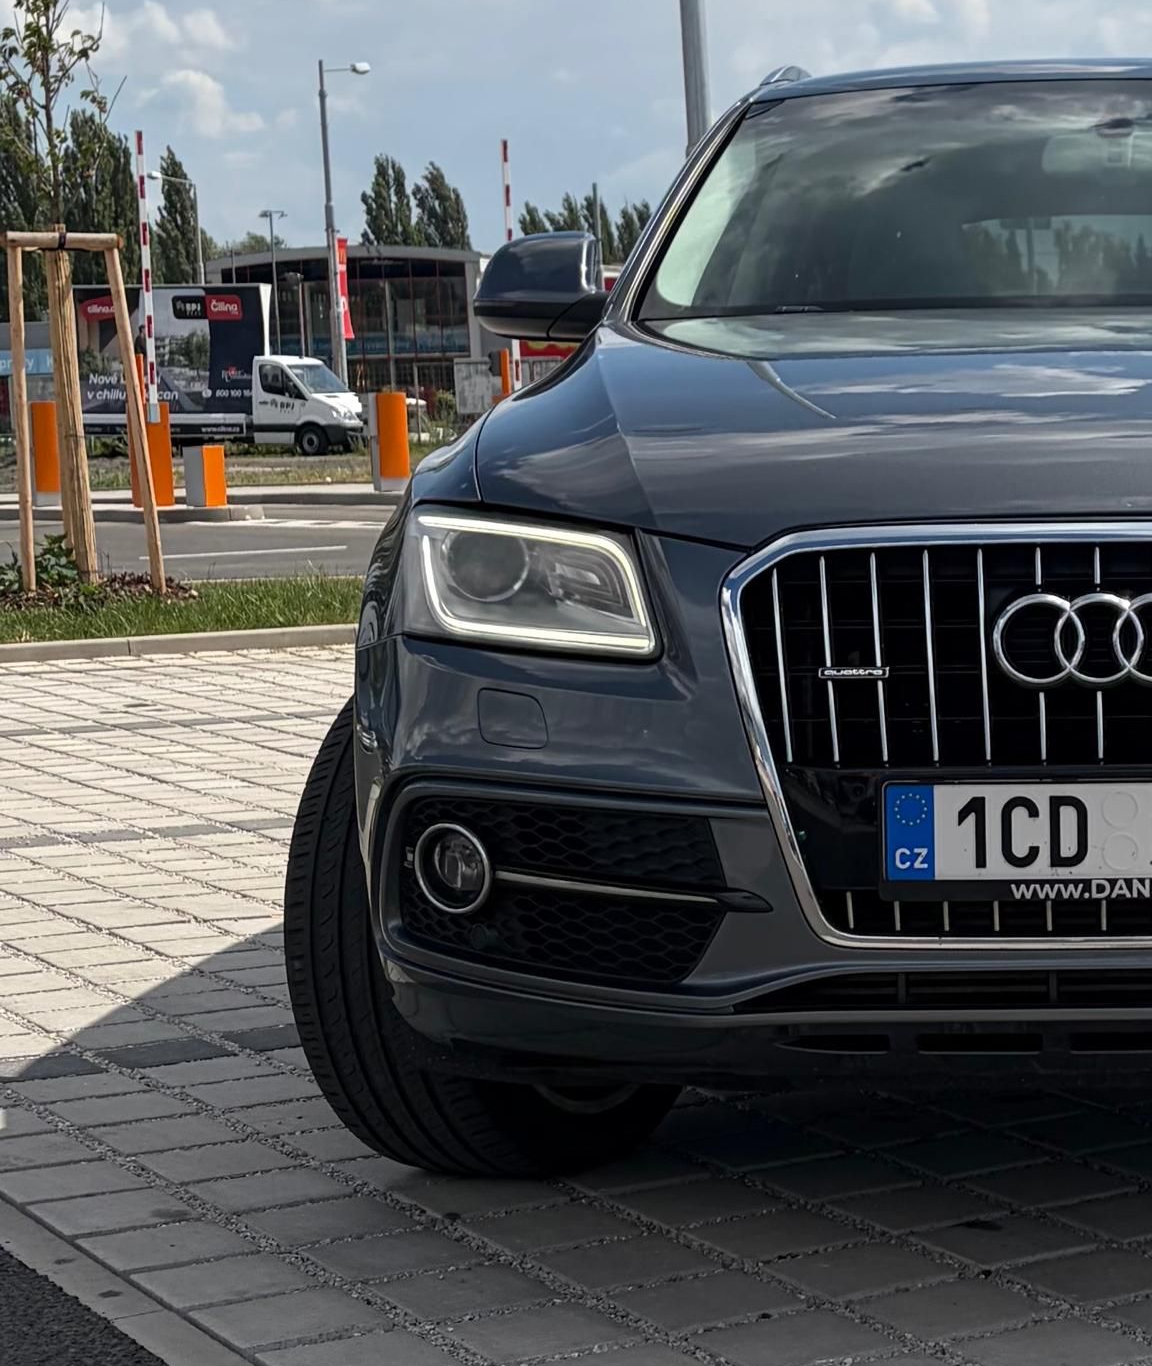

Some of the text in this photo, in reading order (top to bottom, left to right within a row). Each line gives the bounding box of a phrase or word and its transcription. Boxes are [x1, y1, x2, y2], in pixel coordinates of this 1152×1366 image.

[89, 372, 118, 385] Nové
[87, 390, 95, 400] v
[823, 668, 884, 677] quattro
[957, 795, 1089, 869] 1CD
[894, 847, 929, 869] CZ
